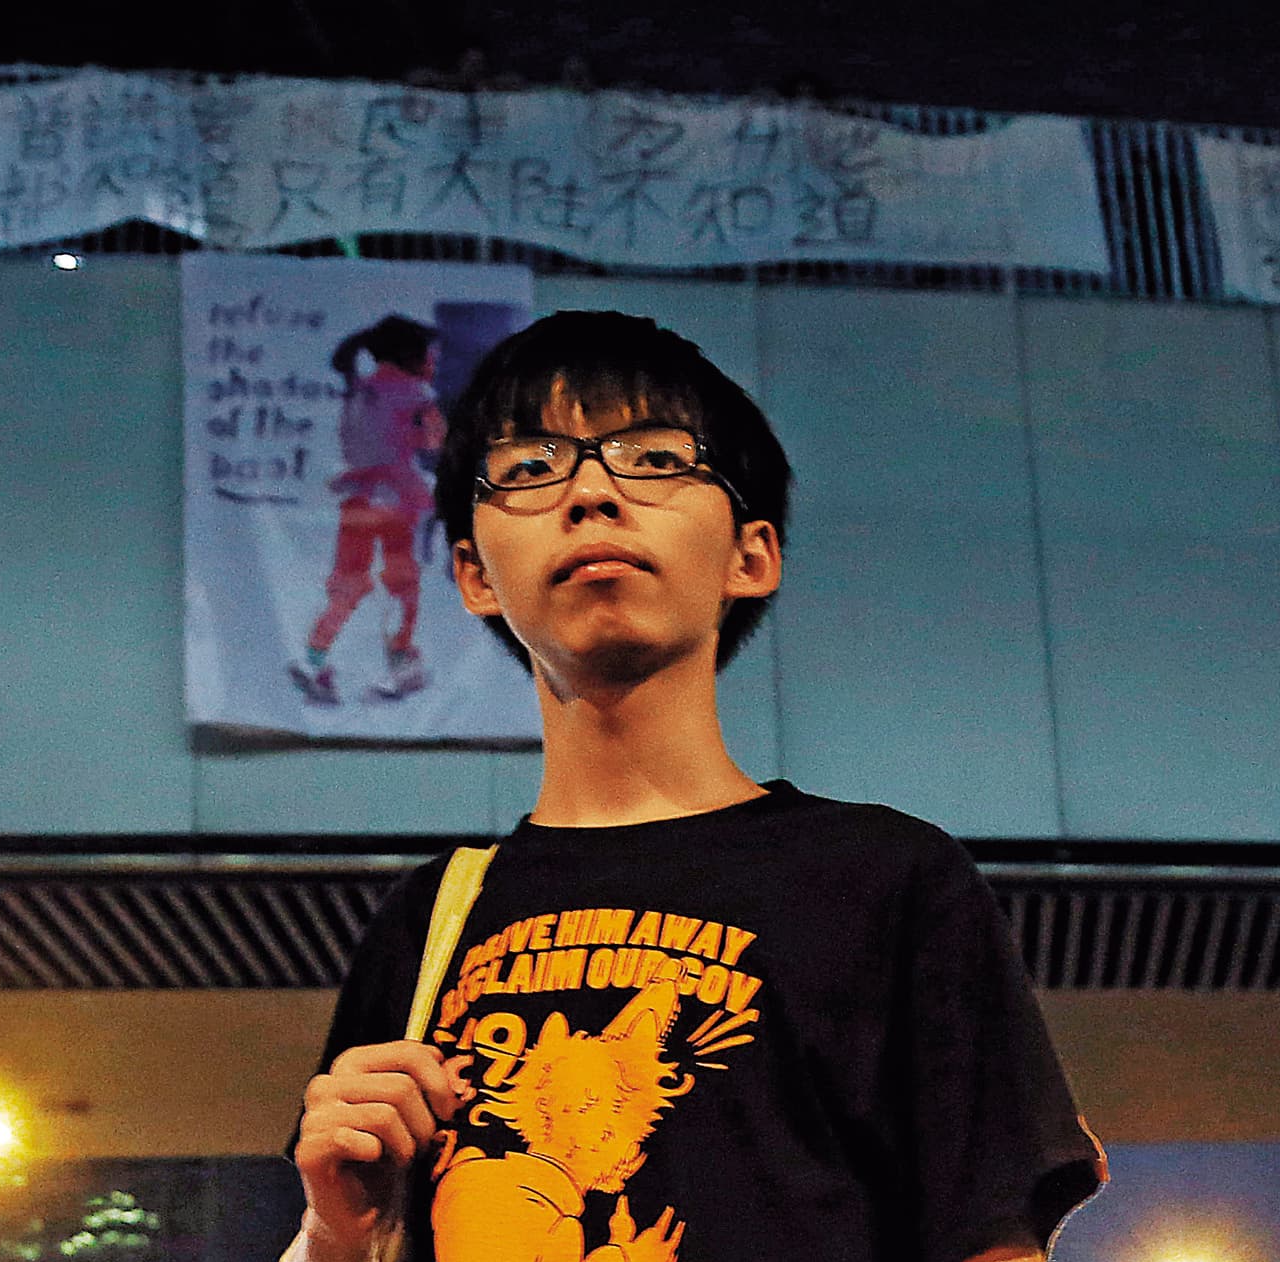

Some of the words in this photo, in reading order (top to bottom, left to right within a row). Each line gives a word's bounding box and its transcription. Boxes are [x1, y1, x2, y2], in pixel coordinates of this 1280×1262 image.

[208, 335, 265, 363] the
[206, 404, 241, 438] of
[255, 404, 315, 438] the
[553, 908, 635, 947] HIM
[627, 910, 758, 966] AWAY
